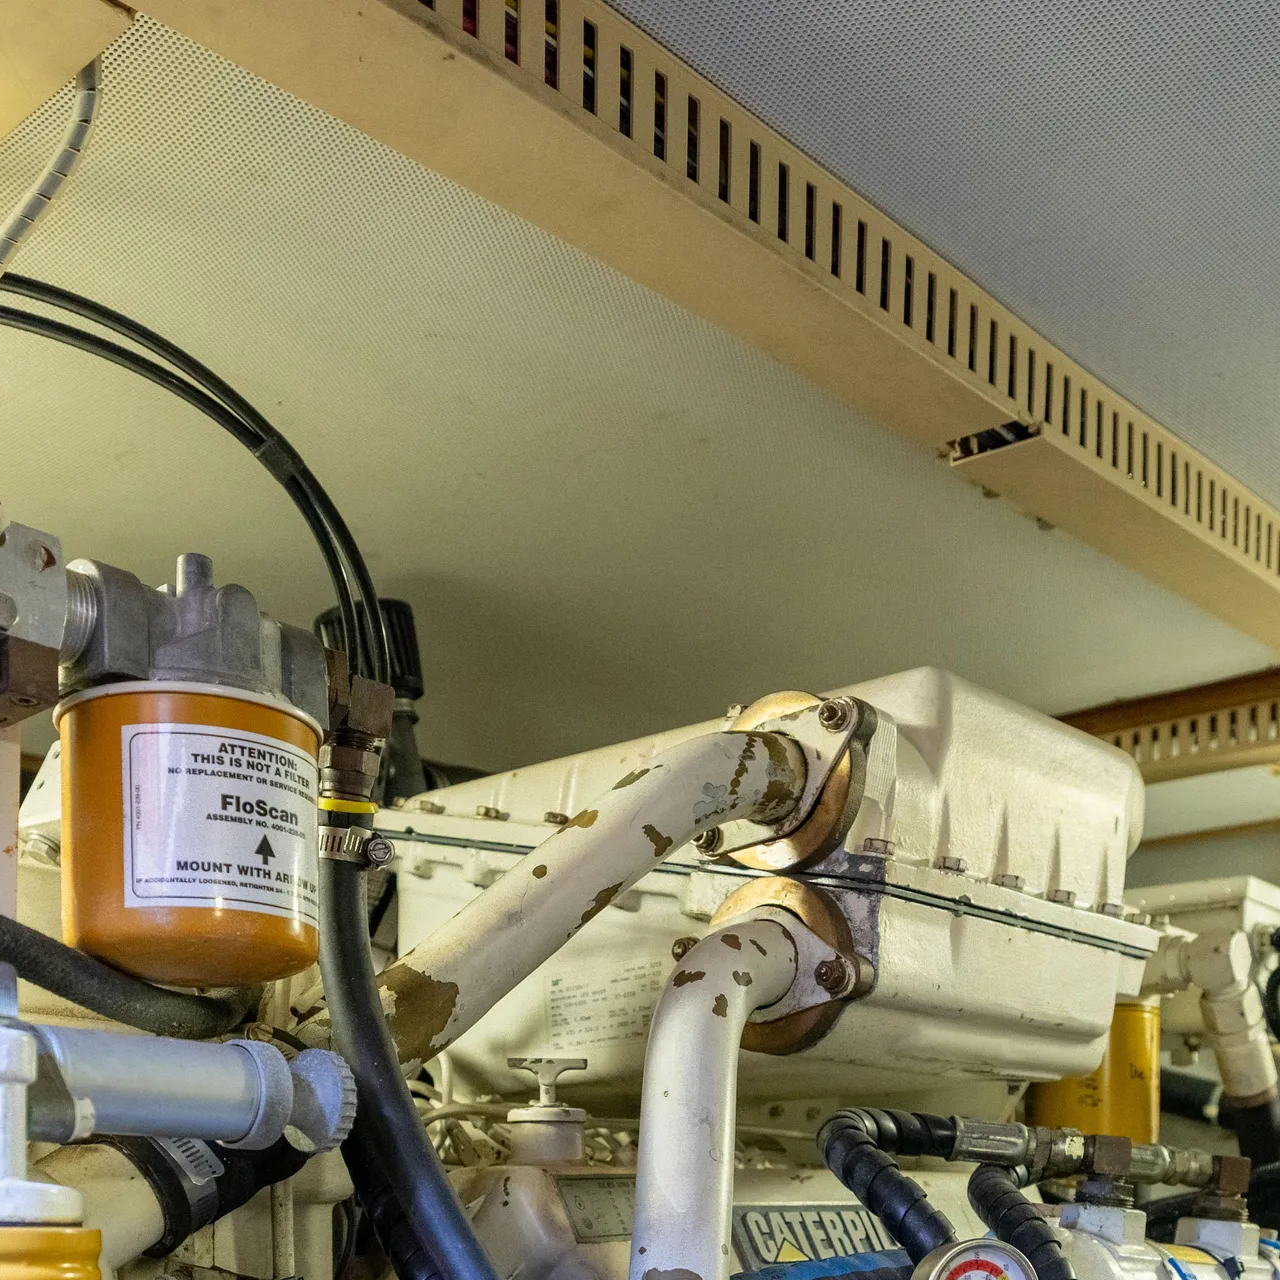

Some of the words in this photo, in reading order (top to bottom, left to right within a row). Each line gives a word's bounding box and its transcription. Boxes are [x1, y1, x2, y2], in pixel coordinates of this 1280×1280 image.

[191, 752, 225, 766] THIS
[229, 756, 242, 768] IS
[246, 759, 271, 775] NOT
[275, 766, 282, 778] A
[284, 769, 310, 789] FILTER
[218, 742, 298, 771] ATTENTION:
[167, 767, 182, 775] NO
[185, 767, 254, 783] REPLACEMENT
[256, 776, 269, 785] OR
[269, 778, 298, 795] SERVICE
[206, 813, 253, 826] ASSEMBLY
[255, 818, 270, 829] NO.
[220, 793, 299, 827] FloScan
[176, 860, 233, 874] MOUNT
[237, 864, 271, 881] WITH
[309, 881, 317, 896] UP
[745, 1208, 901, 1264] CATERPIL
